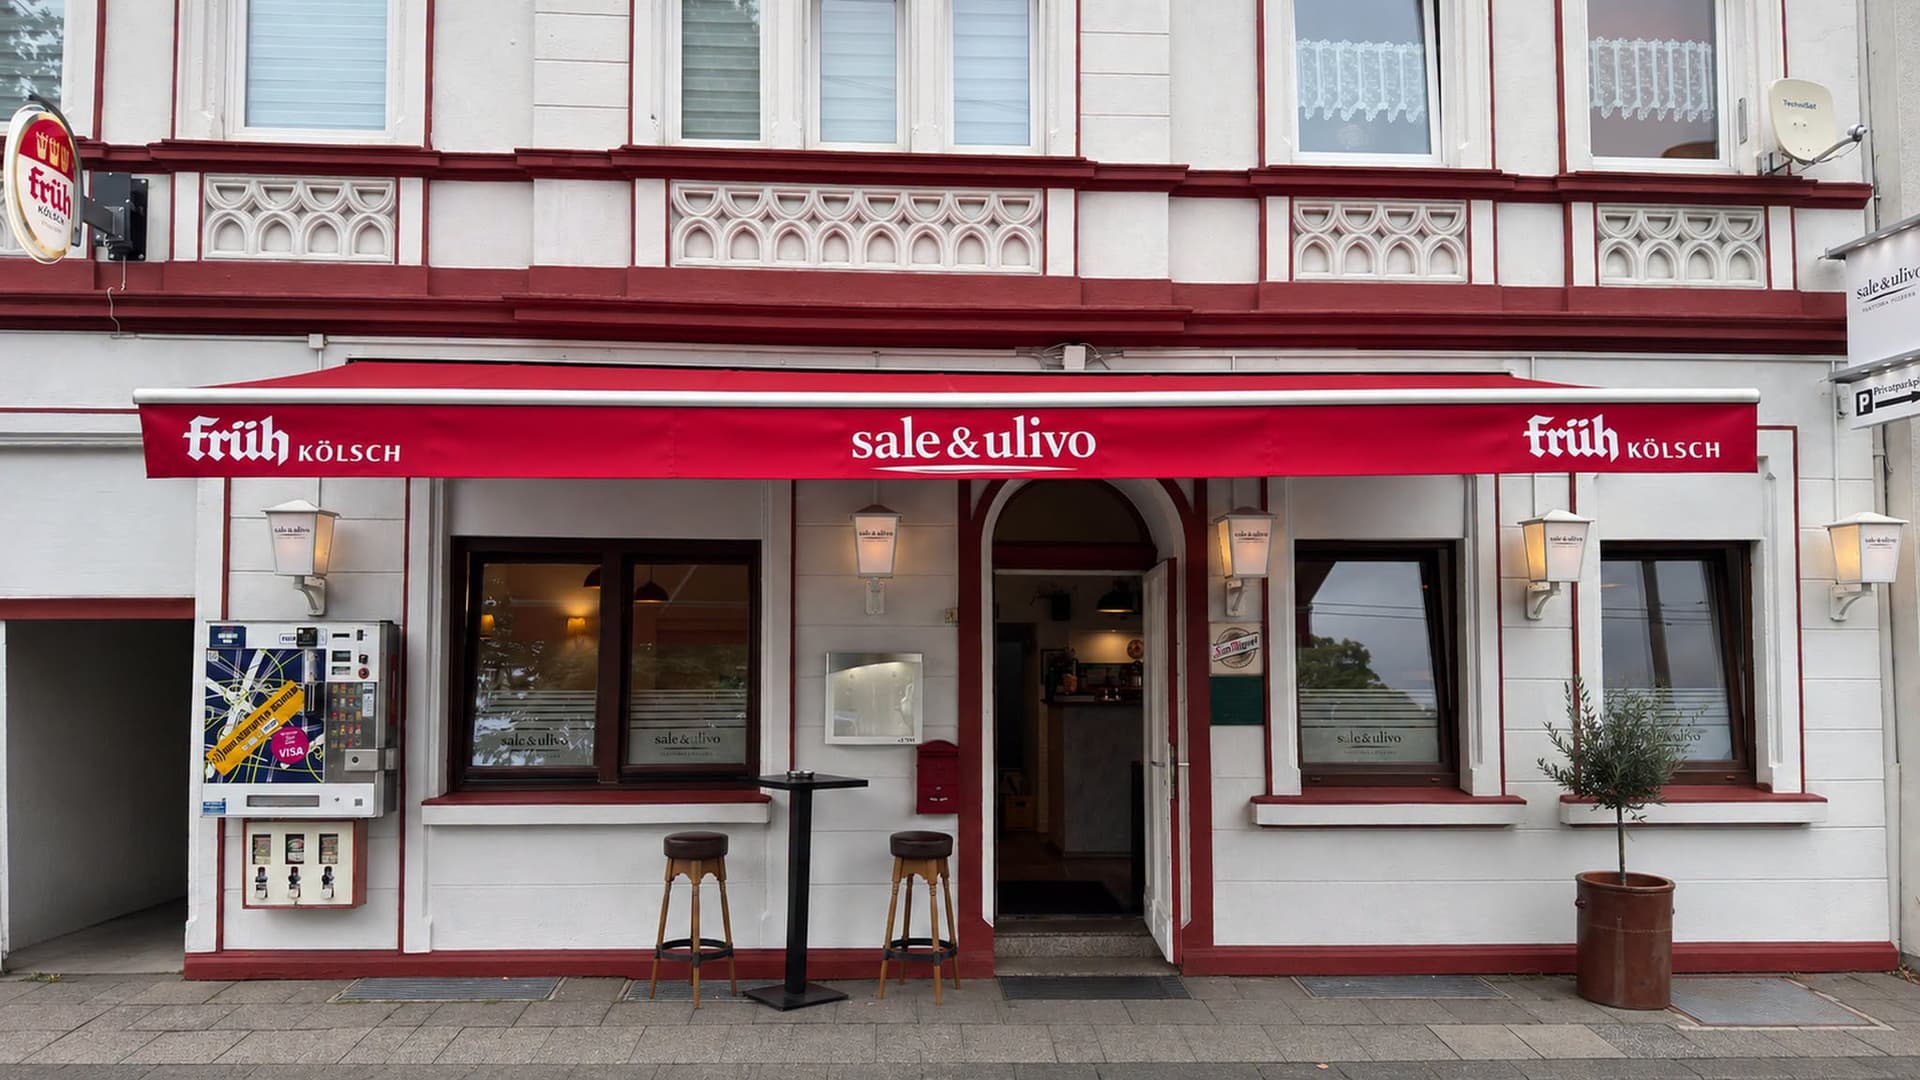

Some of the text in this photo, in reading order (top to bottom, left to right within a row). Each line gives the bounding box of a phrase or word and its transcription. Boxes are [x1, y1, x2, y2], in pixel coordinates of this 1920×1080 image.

[298, 440, 401, 463] KÖLSCH
[1627, 438, 1720, 459] KÖLSCH
[279, 746, 304, 758] VISA
